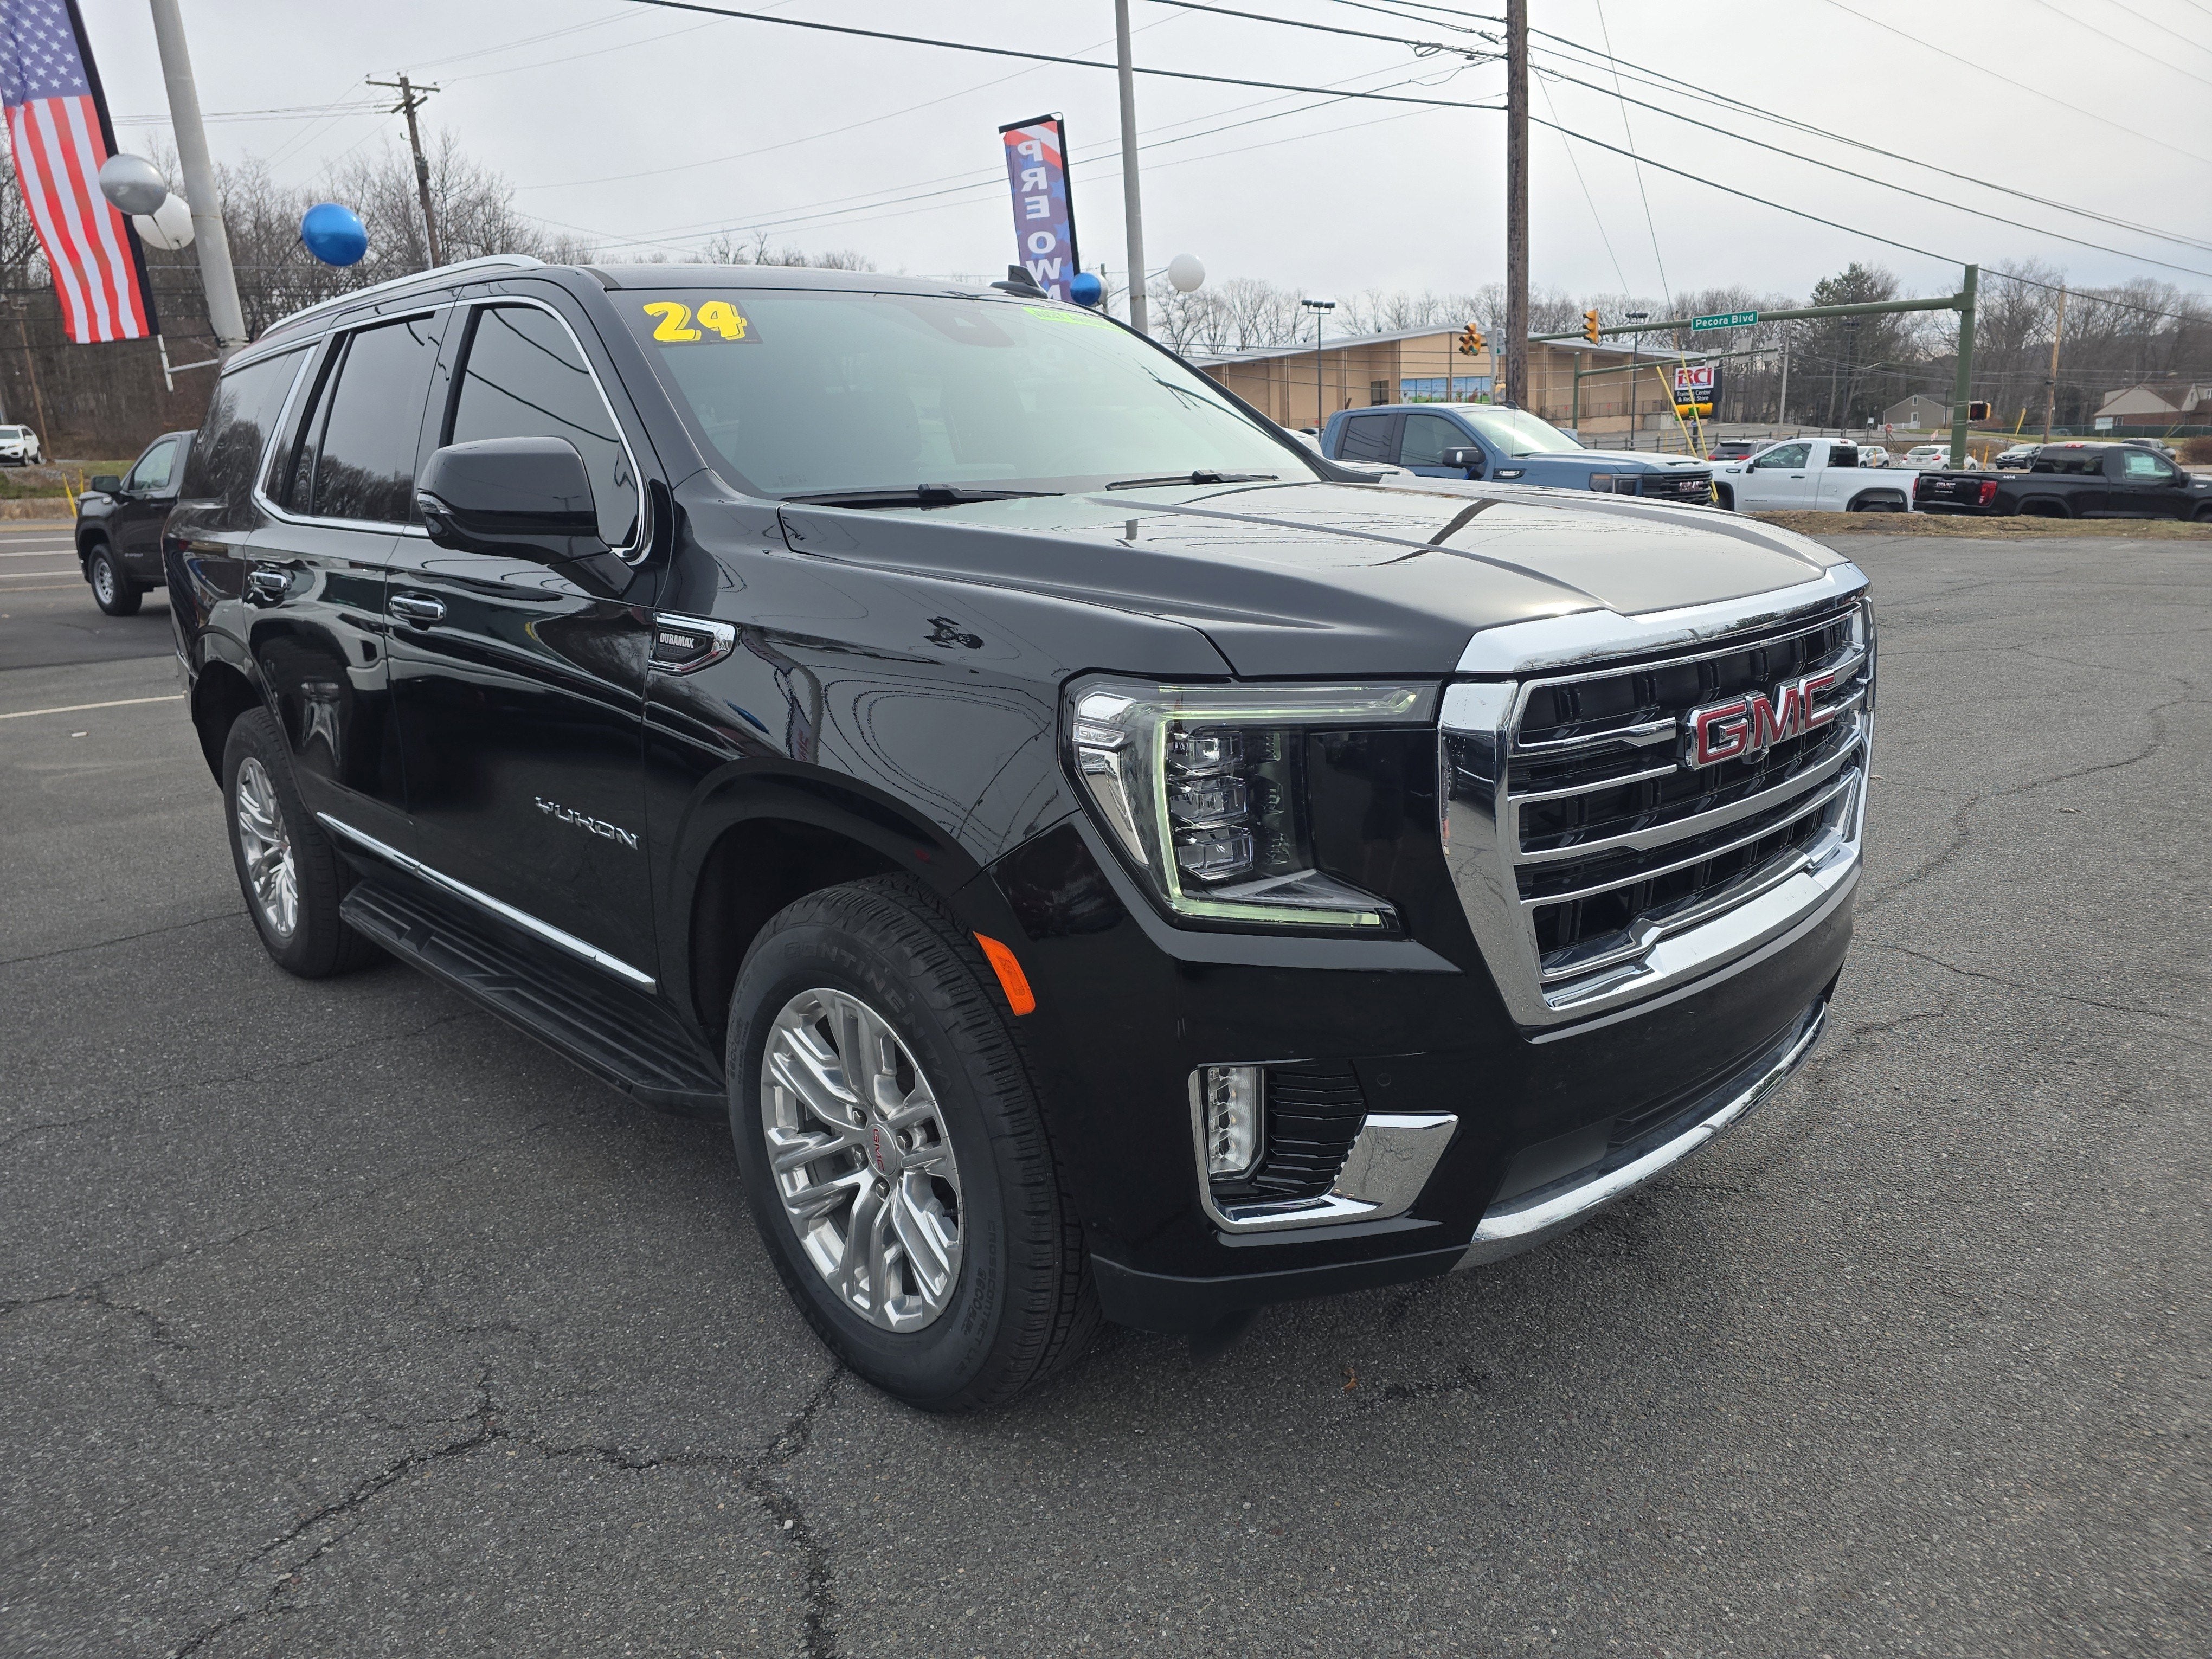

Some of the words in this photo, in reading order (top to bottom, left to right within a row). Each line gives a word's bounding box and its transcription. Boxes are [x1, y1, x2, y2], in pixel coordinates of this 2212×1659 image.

[643, 301, 747, 342] 24
[1695, 317, 1728, 327] Pecora
[1732, 313, 1754, 323] Blvd
[660, 632, 695, 648] DURAMAX
[1690, 670, 1836, 770] GMC
[535, 796, 639, 850] YUKON
[873, 1128, 884, 1171] GMC
